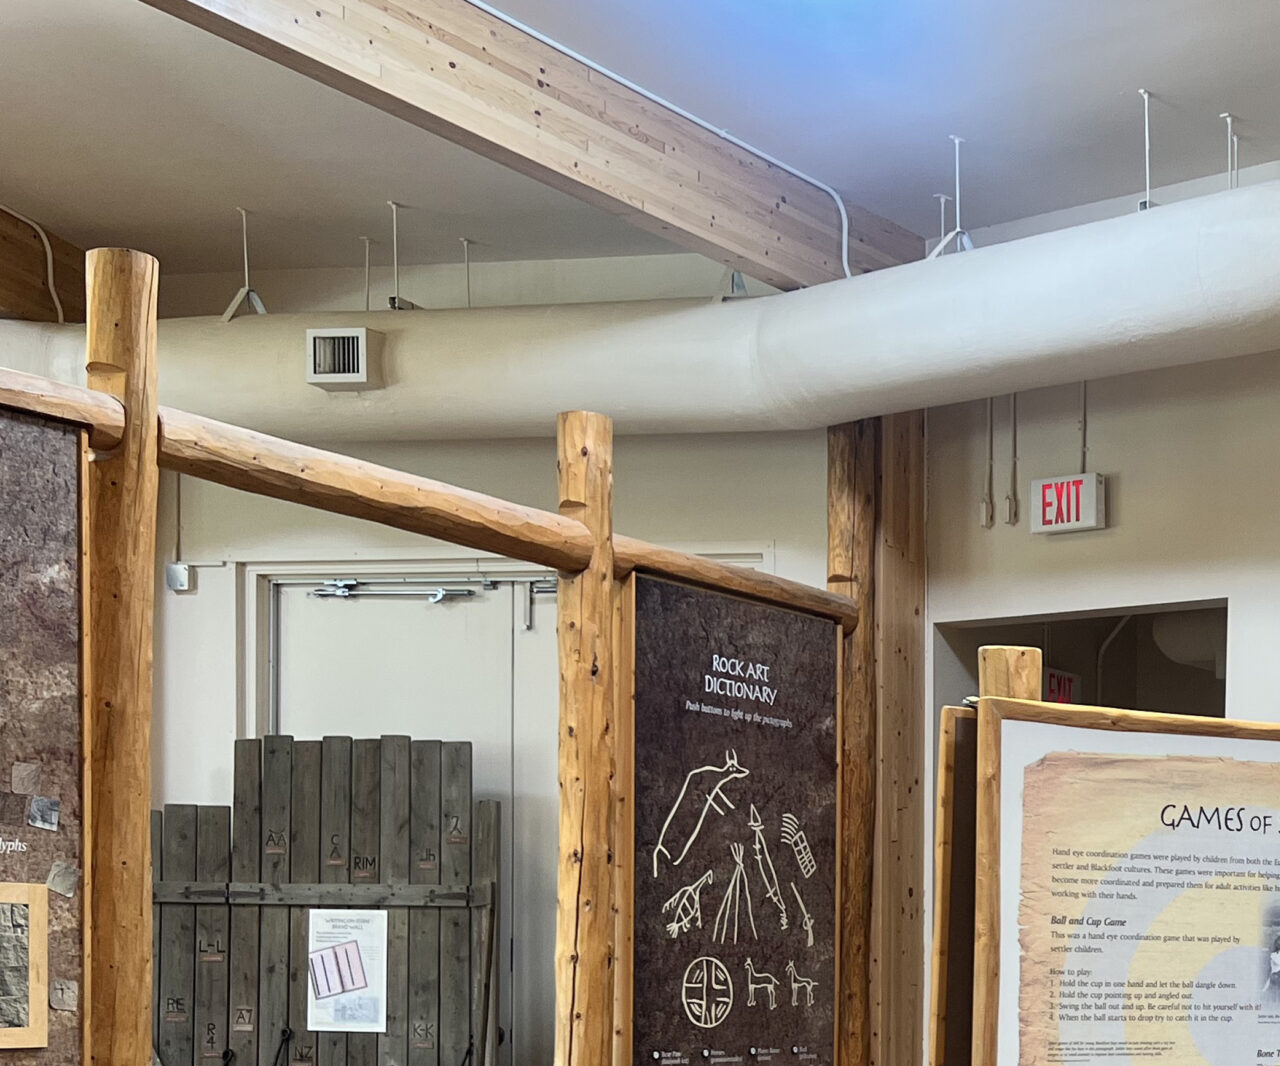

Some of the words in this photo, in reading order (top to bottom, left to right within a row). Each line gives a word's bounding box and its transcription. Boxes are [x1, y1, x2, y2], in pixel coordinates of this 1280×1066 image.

[1042, 479, 1084, 526] EXIT
[712, 654, 744, 678] ROCK
[746, 662, 770, 682] ART
[704, 674, 777, 706] DICTIONARY
[1048, 673, 1074, 704] EXIT
[686, 700, 699, 710] Push
[701, 703, 722, 714] buttons
[731, 709, 744, 720] light
[745, 714, 753, 723] up
[753, 712, 762, 721] the
[1160, 804, 1245, 832] GAMES
[1250, 816, 1272, 834] OF
[354, 856, 376, 870] RIM
[1051, 915, 1067, 925] Ball
[1068, 916, 1084, 925] and
[1086, 916, 1102, 928] Cup
[1104, 917, 1127, 926] Game
